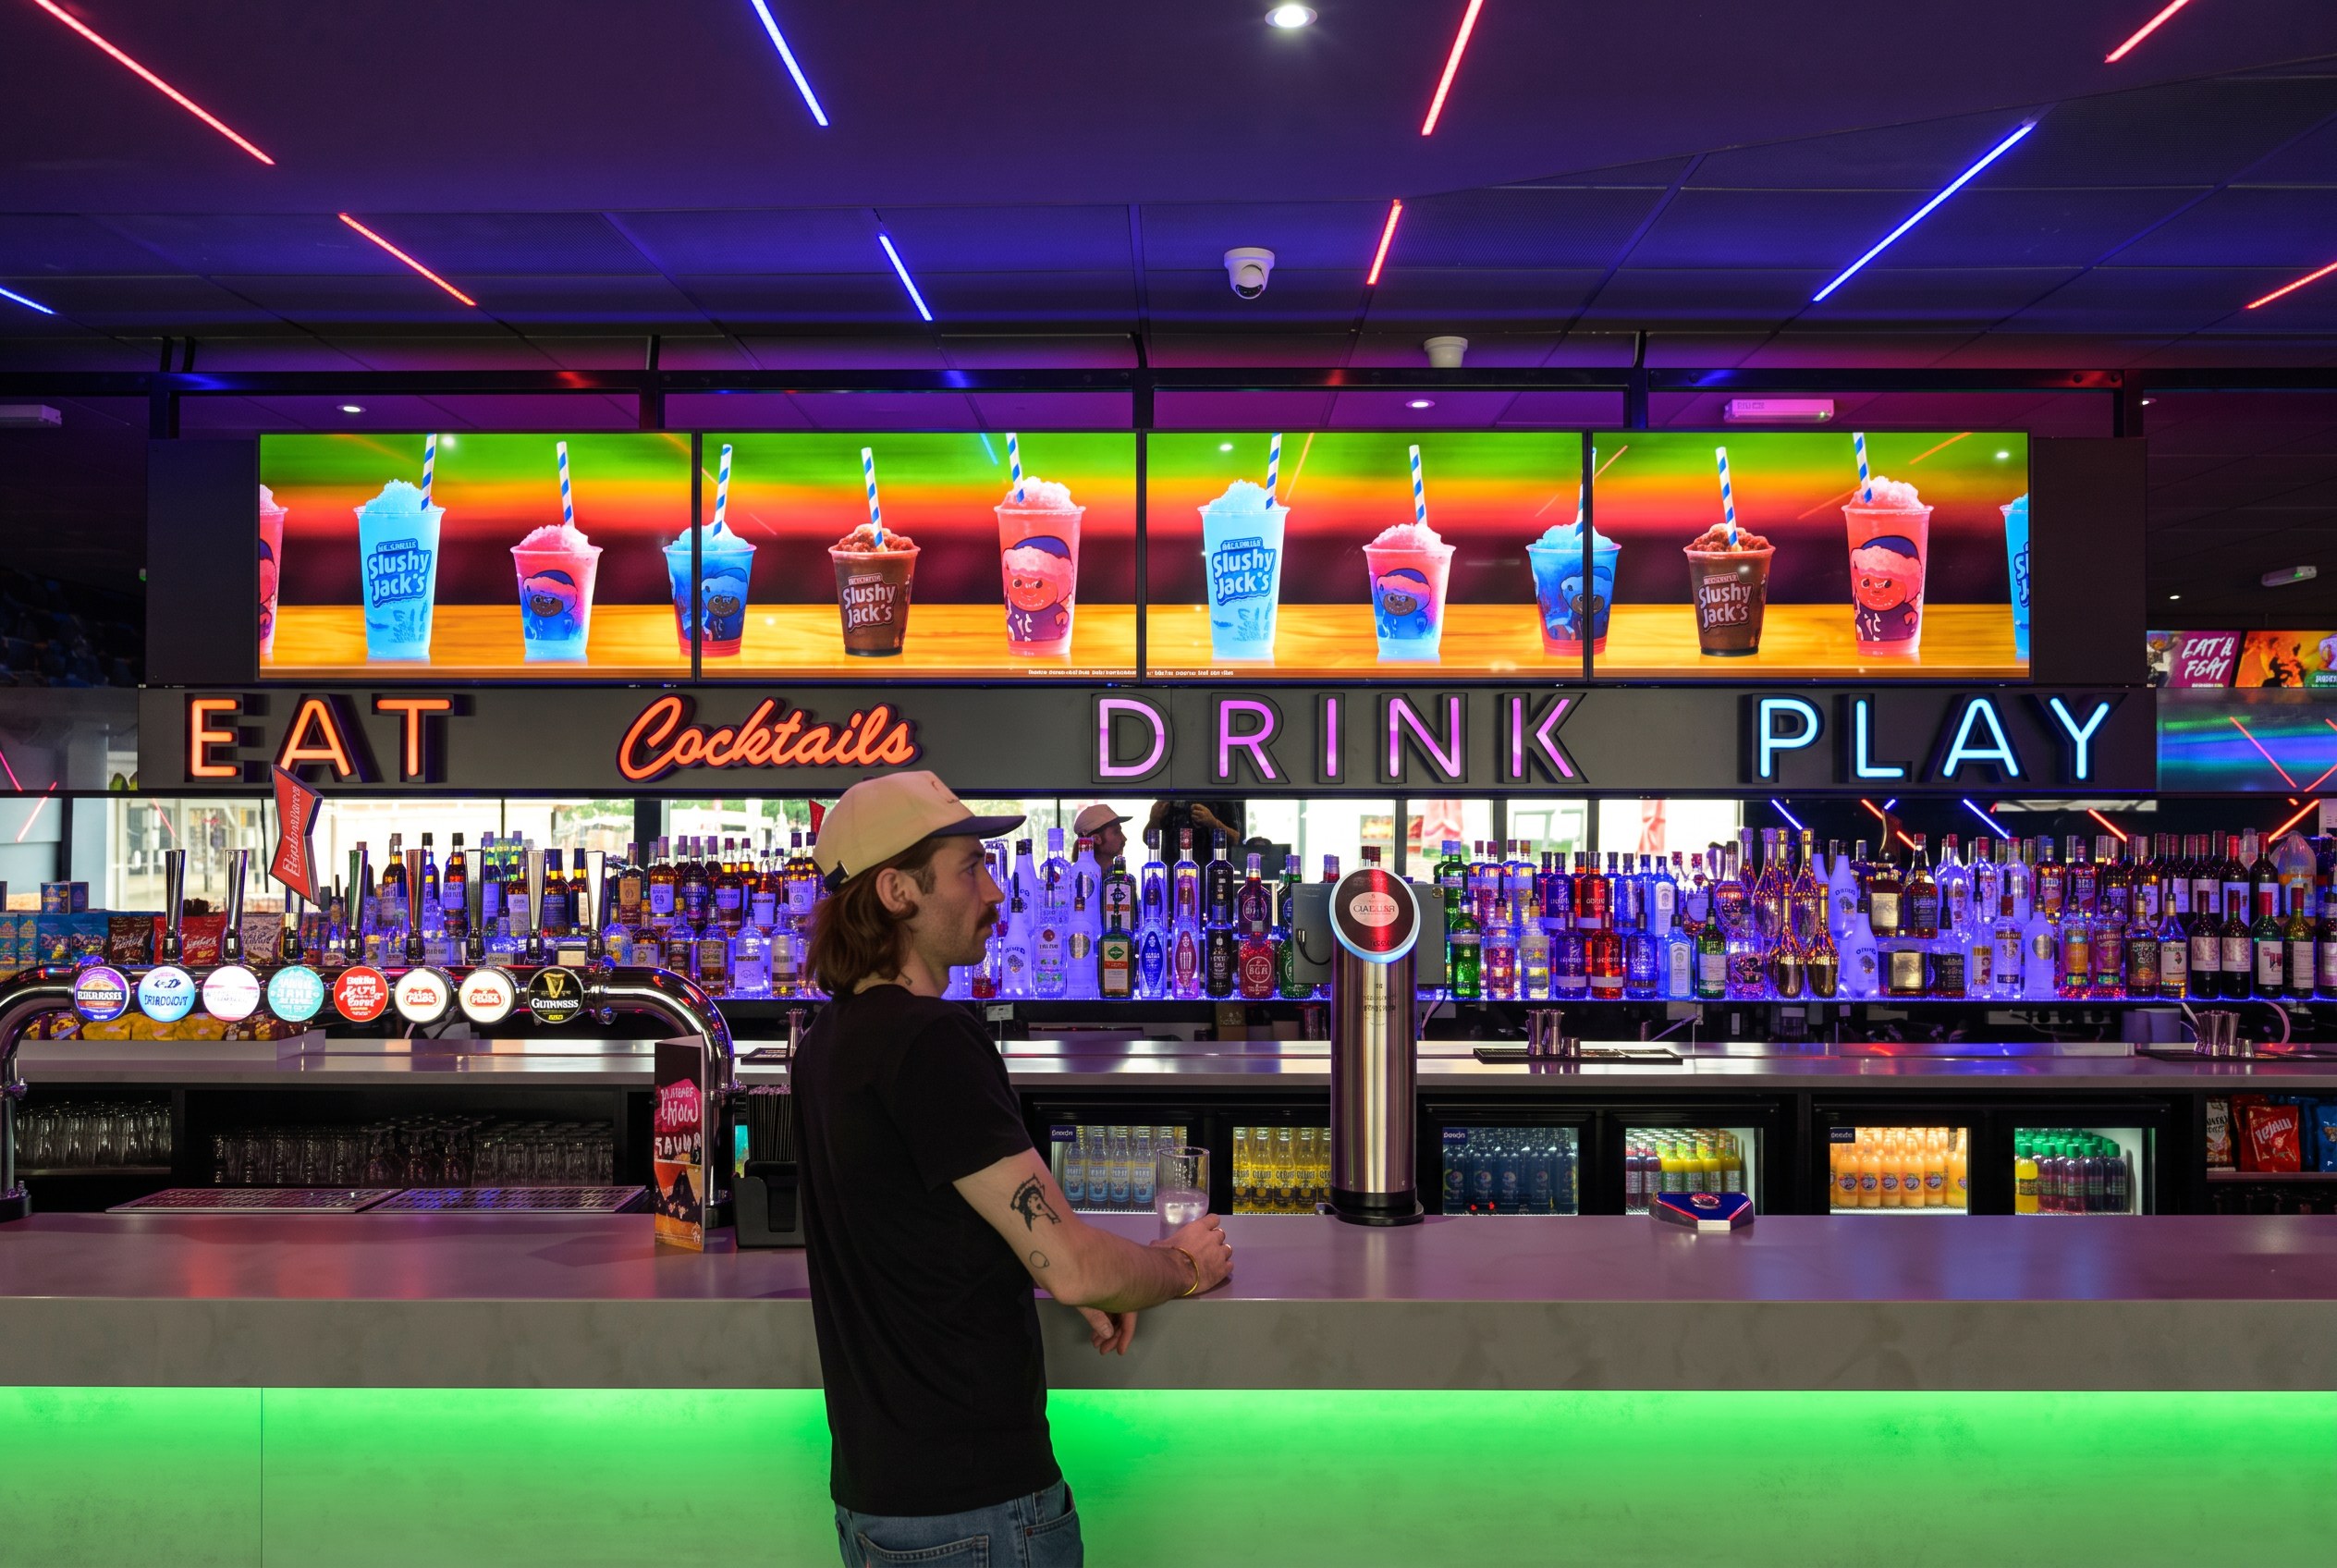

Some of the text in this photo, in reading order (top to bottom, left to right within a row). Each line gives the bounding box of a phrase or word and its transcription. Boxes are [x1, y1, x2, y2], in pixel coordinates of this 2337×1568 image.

[368, 550, 430, 580] Slushy
[1212, 548, 1275, 578] Slushy
[371, 572, 425, 602] Jack's
[842, 583, 896, 609] Slushy
[1214, 571, 1270, 600] Jack's
[1698, 582, 1752, 609] Slushy
[847, 604, 892, 629] Jack's
[1703, 603, 1749, 629] Jack's
[190, 698, 453, 778] EAT
[618, 695, 915, 781] Cocktails
[1098, 698, 1575, 779] DRINK
[1759, 697, 2111, 779] PLAY
